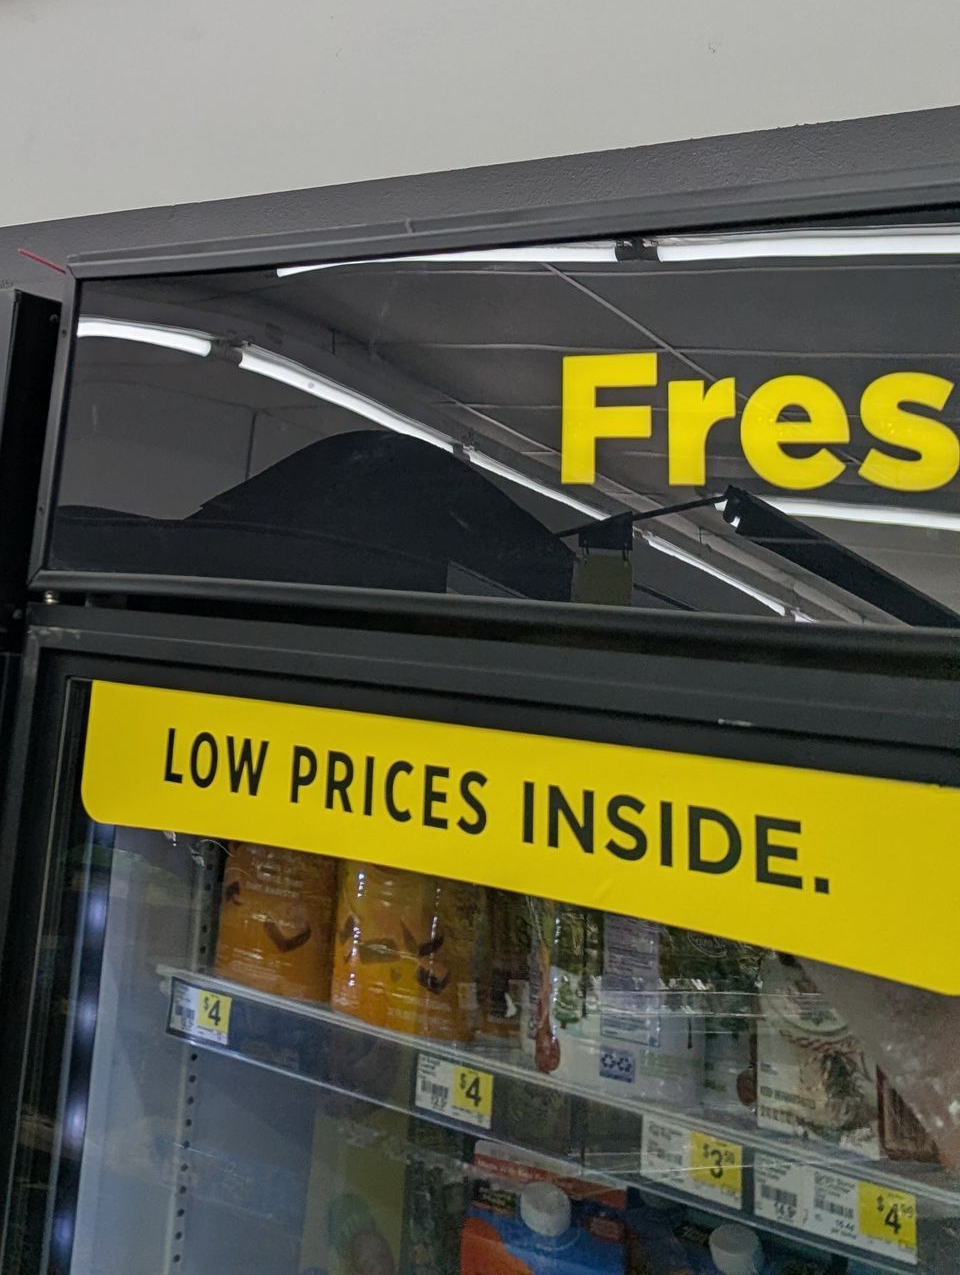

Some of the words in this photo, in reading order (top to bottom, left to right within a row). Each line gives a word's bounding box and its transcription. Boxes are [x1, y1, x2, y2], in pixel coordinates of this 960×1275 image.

[560, 352, 960, 492] Fres
[164, 728, 269, 797] LOW
[289, 746, 488, 836] PRICES
[522, 779, 831, 895] INSIDE.
[203, 996, 221, 1026] $4
[460, 1073, 482, 1107] $4
